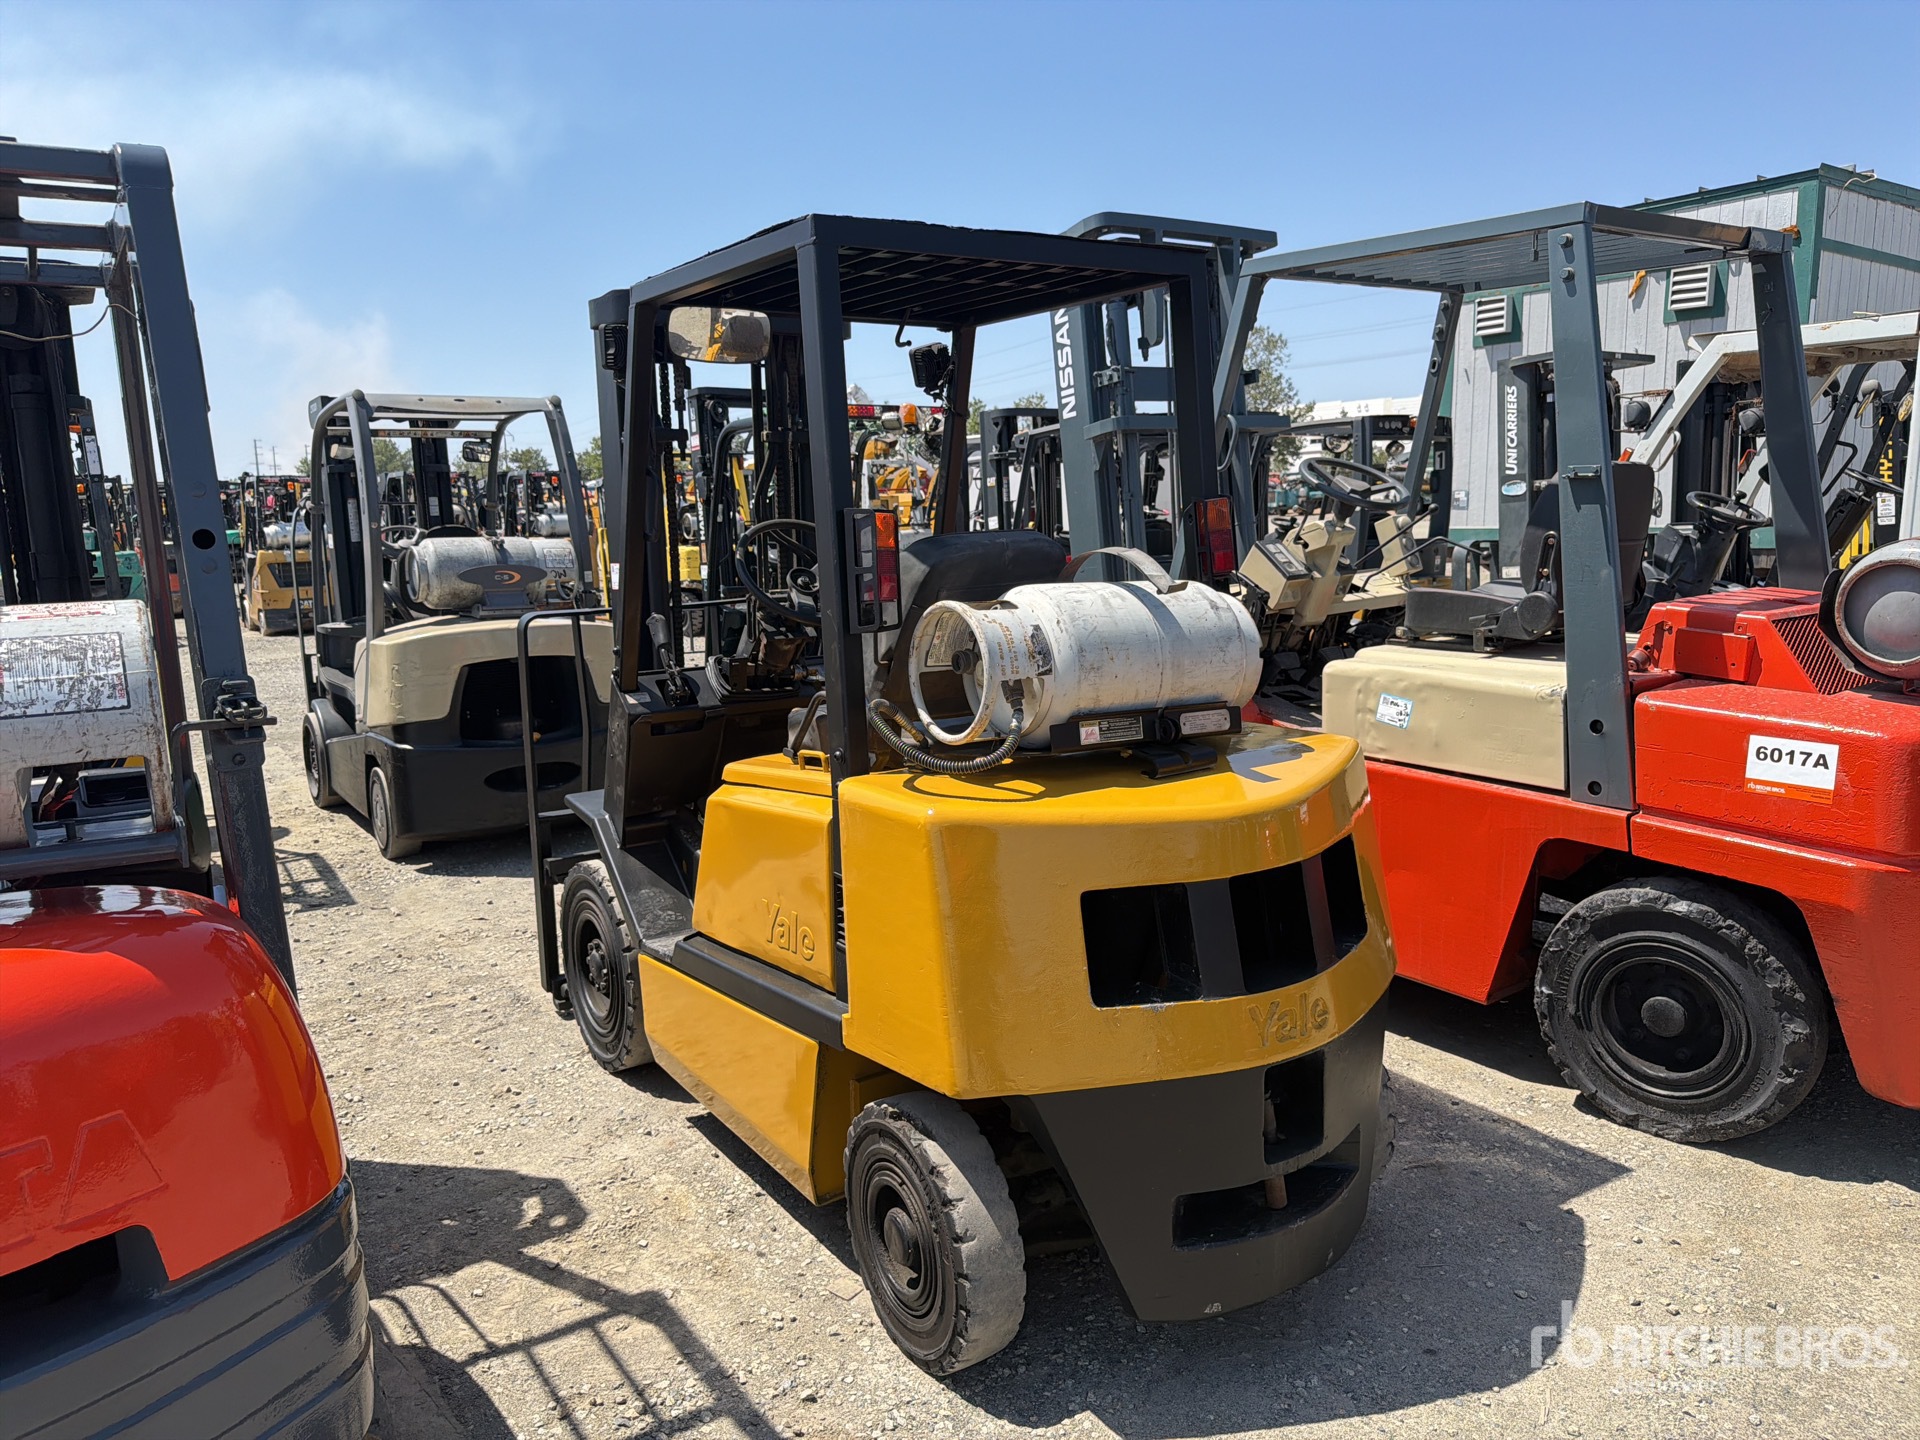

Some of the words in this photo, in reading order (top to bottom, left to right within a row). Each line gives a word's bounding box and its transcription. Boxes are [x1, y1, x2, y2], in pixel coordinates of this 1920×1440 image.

[1054, 308, 1077, 420] NISSAN
[1504, 385, 1518, 475] UNICARRIERS
[1755, 745, 1830, 771] 6017A
[761, 898, 815, 962] Yale
[1247, 991, 1330, 1049] Yale
